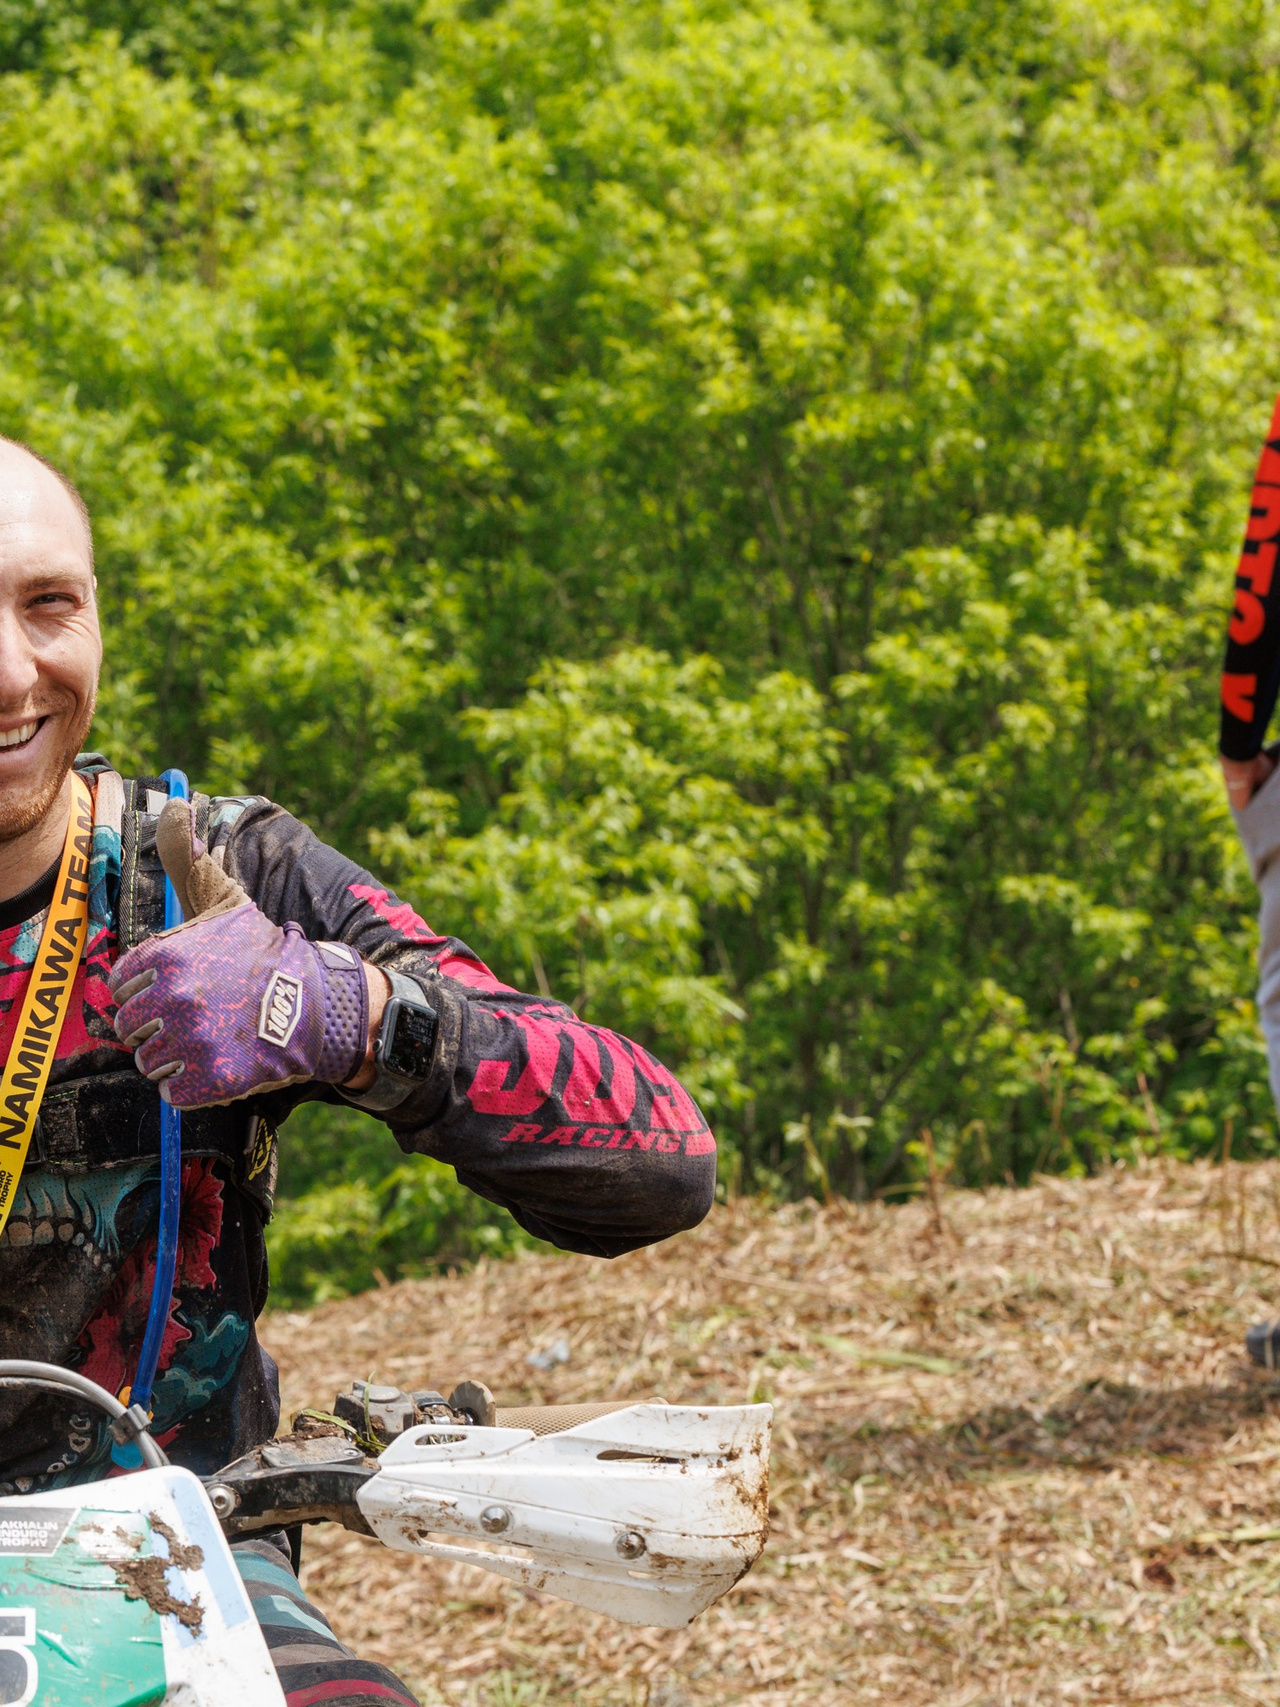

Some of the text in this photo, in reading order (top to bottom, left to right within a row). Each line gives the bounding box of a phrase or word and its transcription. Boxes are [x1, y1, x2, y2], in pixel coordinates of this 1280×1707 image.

[61, 797, 95, 905] TEAM
[267, 979, 297, 1037] 100%
[501, 1122, 682, 1153] RACING
